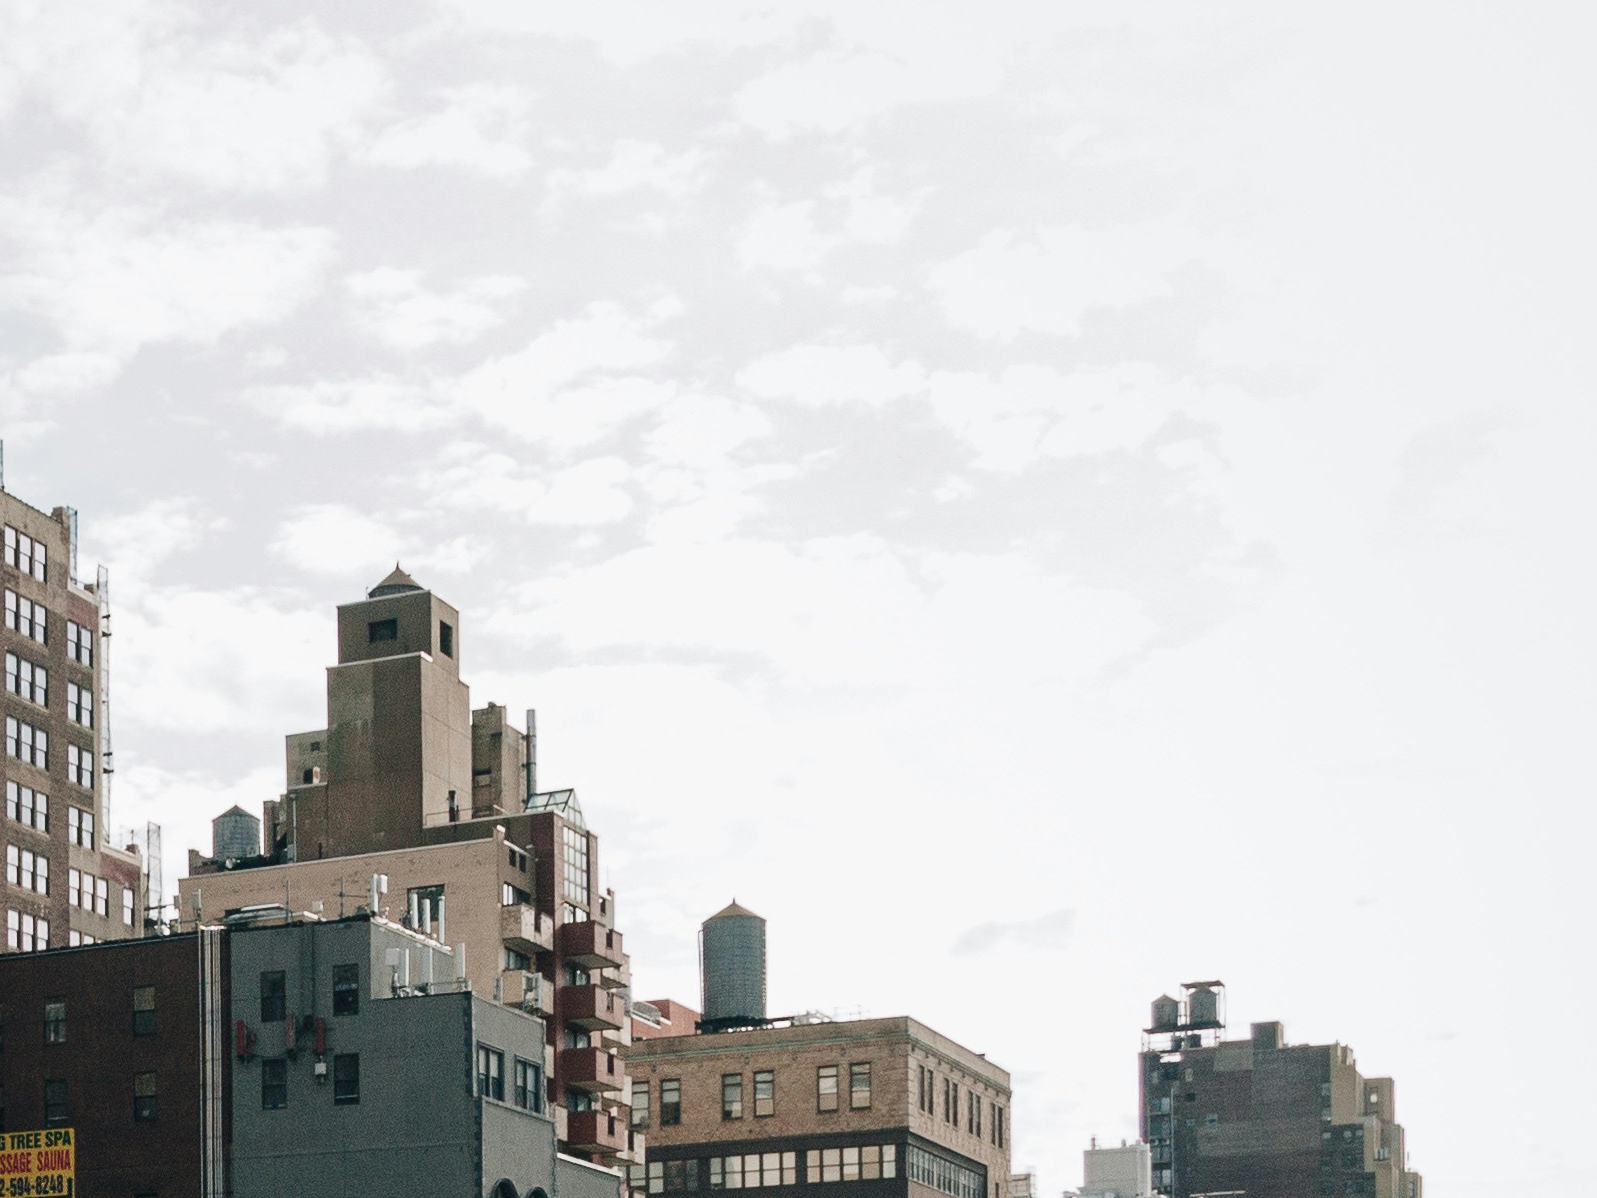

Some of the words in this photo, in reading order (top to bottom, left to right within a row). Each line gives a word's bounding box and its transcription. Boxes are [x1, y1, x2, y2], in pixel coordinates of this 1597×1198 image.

[9, 1132, 42, 1150] TREE
[45, 1130, 71, 1147] SPA
[37, 1149, 71, 1171] SAUNA
